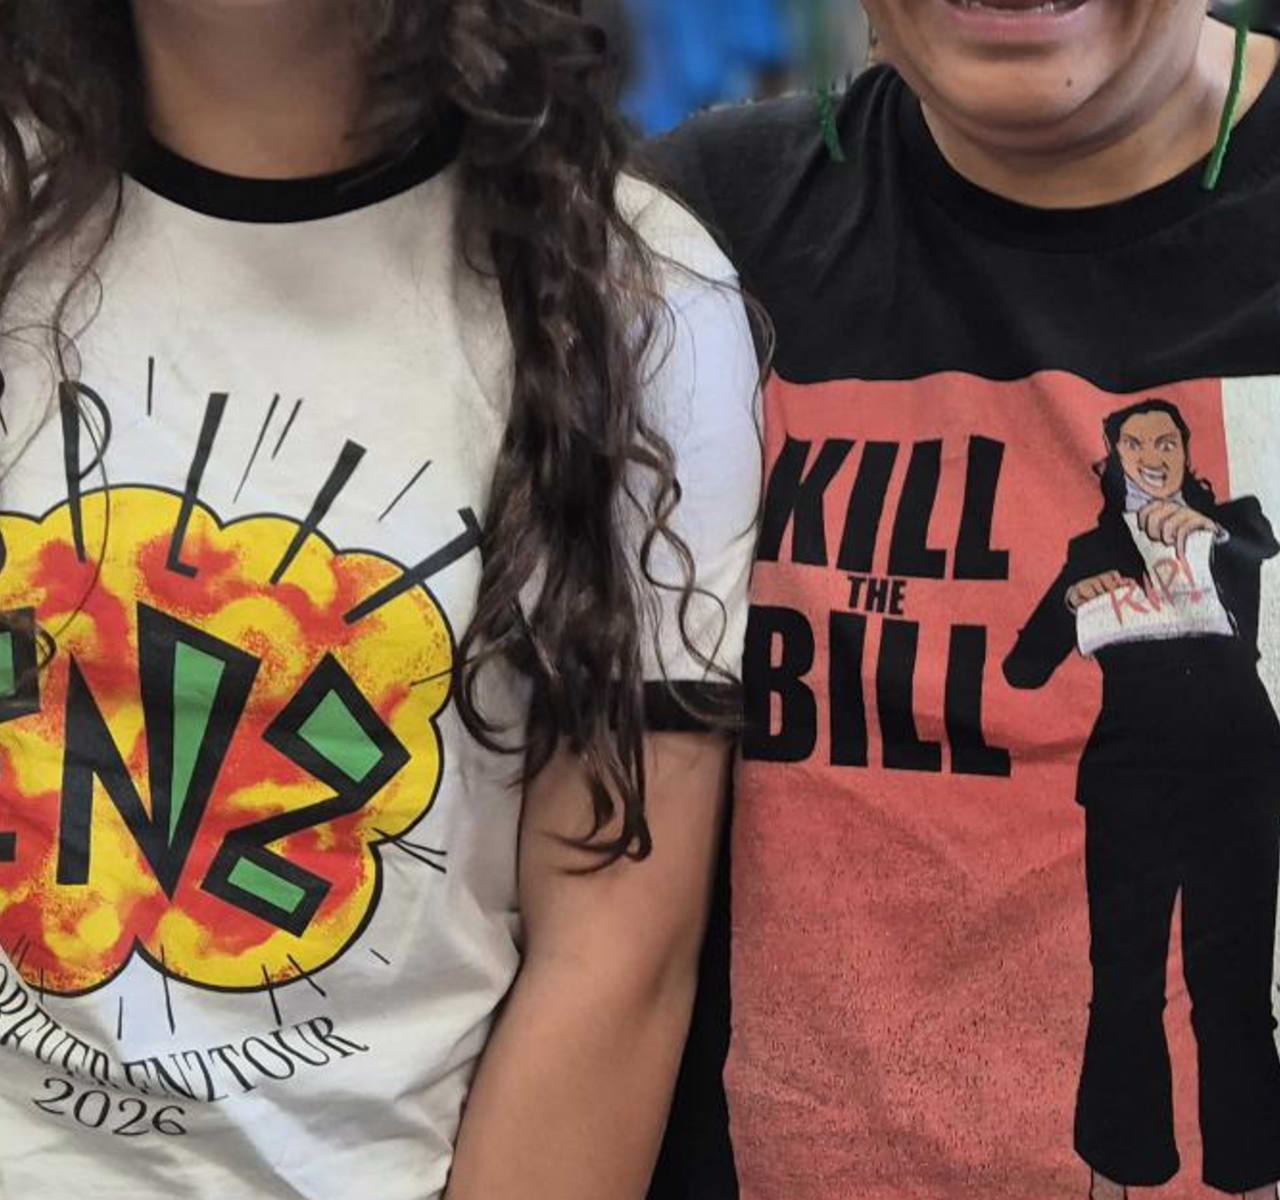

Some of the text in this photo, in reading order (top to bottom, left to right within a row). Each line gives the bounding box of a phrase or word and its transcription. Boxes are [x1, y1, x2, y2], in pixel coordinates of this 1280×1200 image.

[757, 433, 1010, 581] KILL
[848, 575, 908, 615] THE
[742, 604, 1012, 778] BILL
[32, 1076, 188, 1137] 2026
